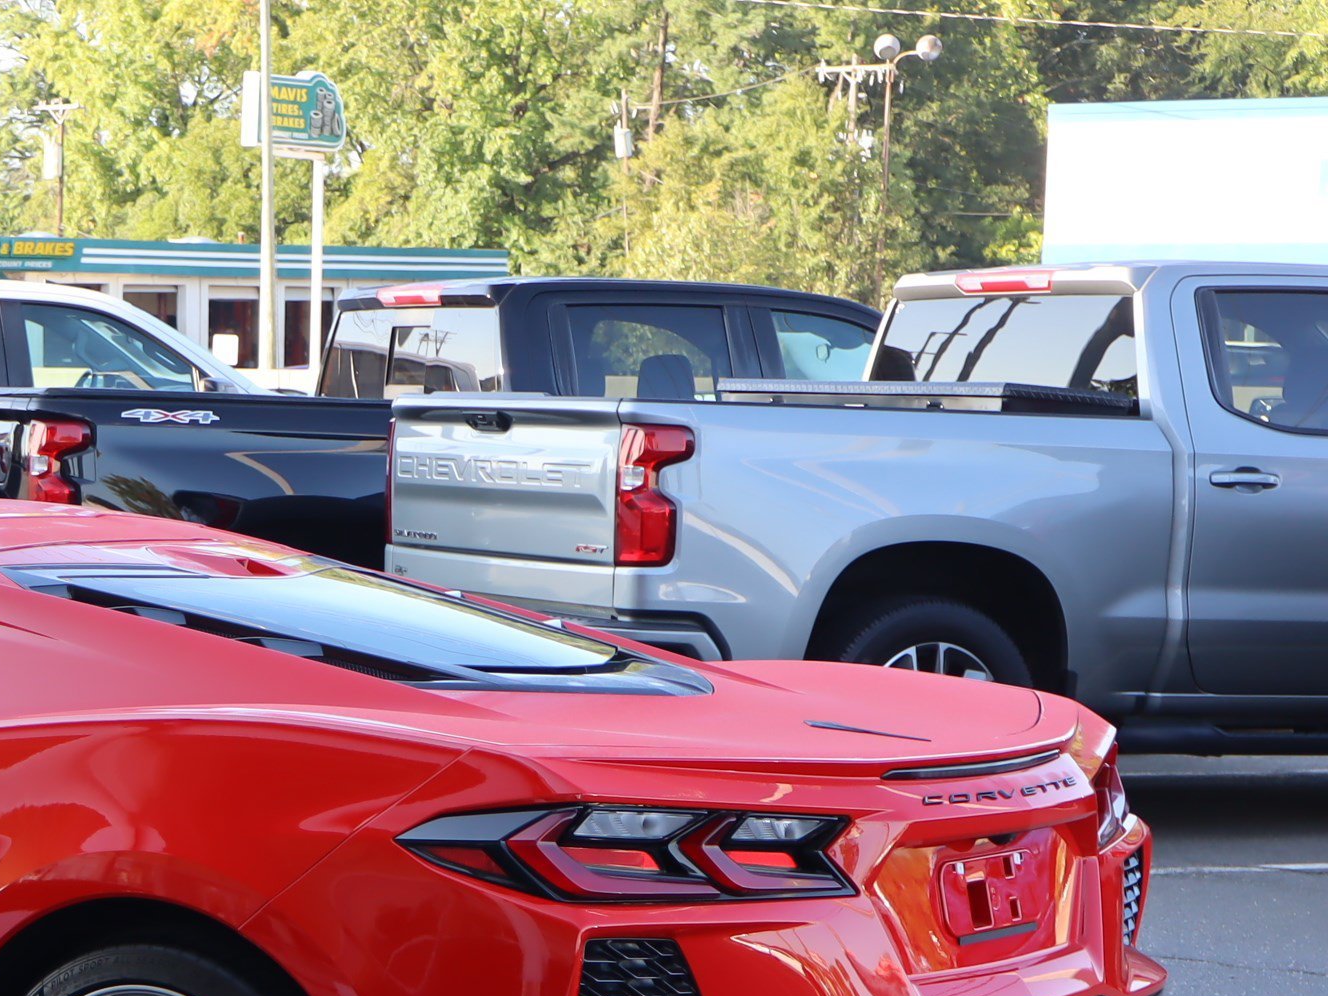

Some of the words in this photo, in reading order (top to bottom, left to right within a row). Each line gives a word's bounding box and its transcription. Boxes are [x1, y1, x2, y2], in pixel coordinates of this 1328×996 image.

[0, 242, 10, 255] &
[13, 242, 75, 256] BRAKES
[396, 455, 594, 488] CHEVROLET
[922, 776, 1078, 805] CORVETTE
[50, 970, 74, 990] PILOT
[78, 957, 112, 975] SPORT
